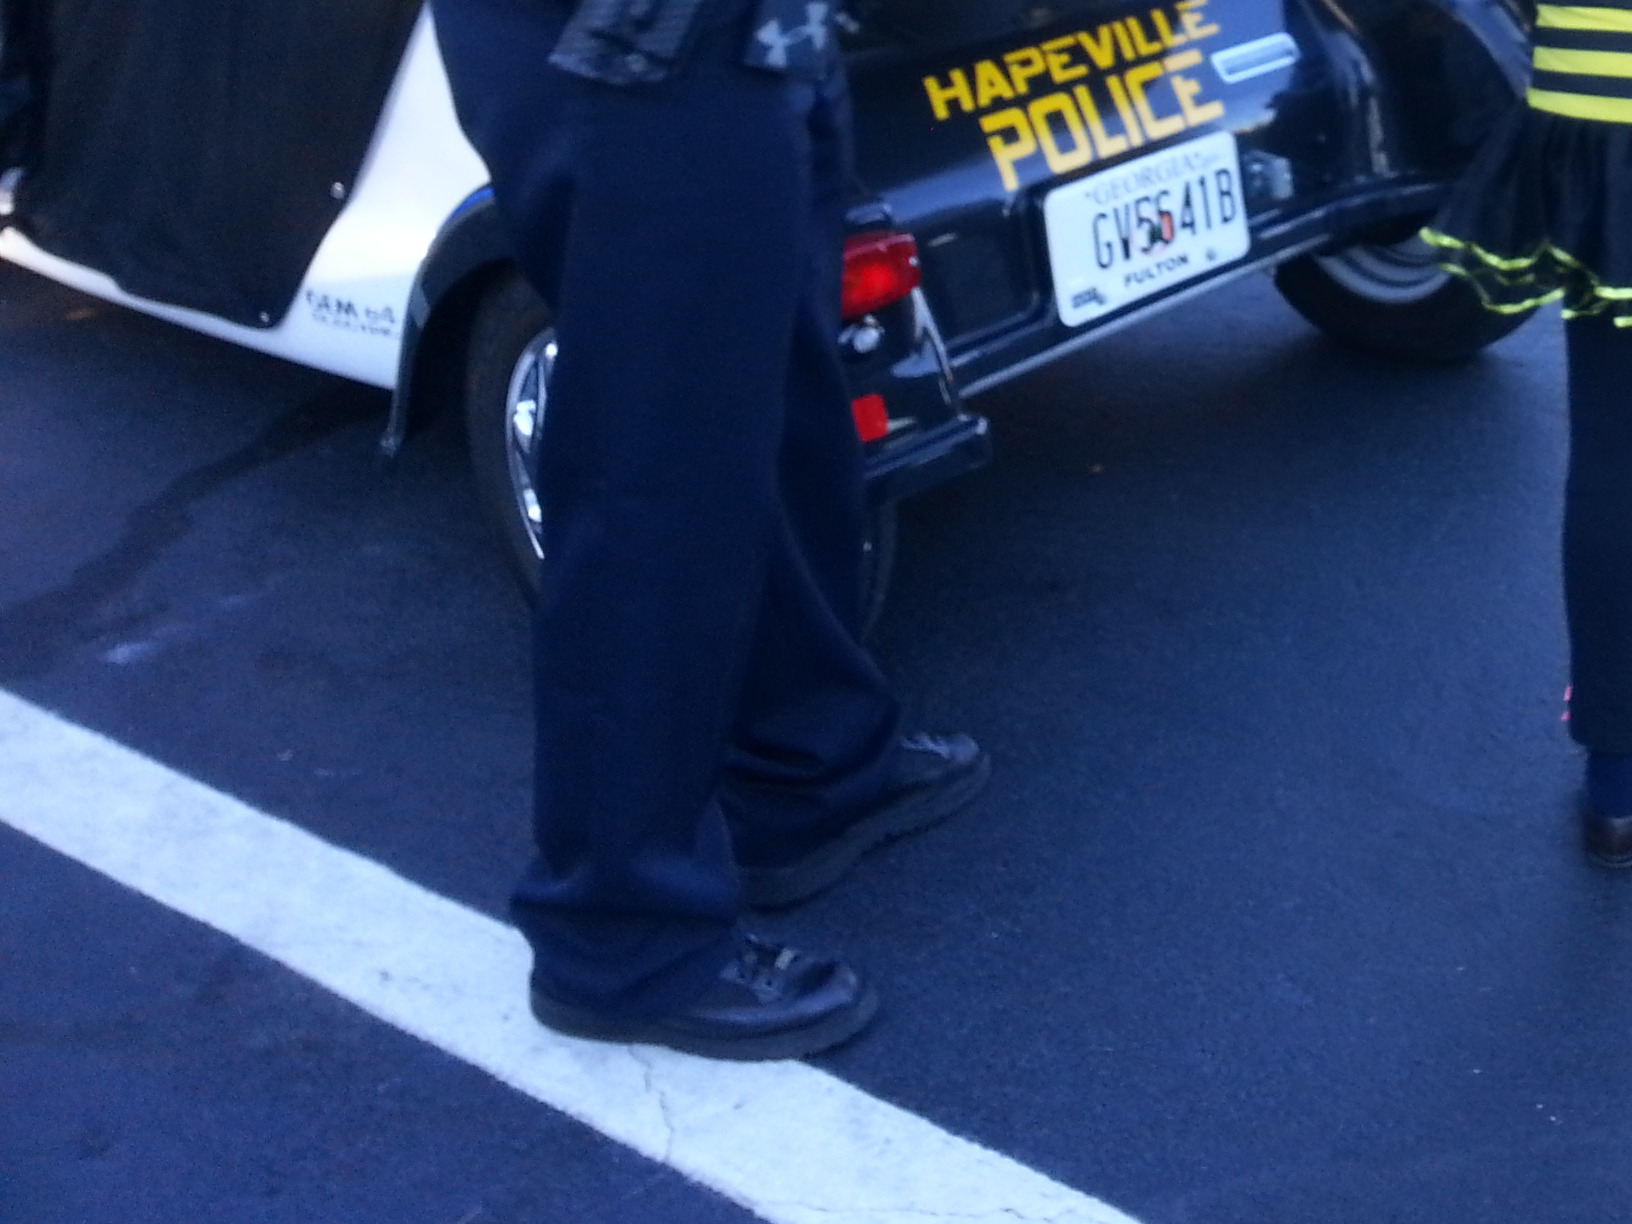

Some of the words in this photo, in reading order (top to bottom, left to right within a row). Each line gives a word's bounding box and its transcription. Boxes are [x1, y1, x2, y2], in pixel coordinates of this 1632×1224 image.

[978, 48, 1225, 191] POLICE
[1091, 168, 1237, 270] GV5641B
[1123, 251, 1190, 287] FULTON
